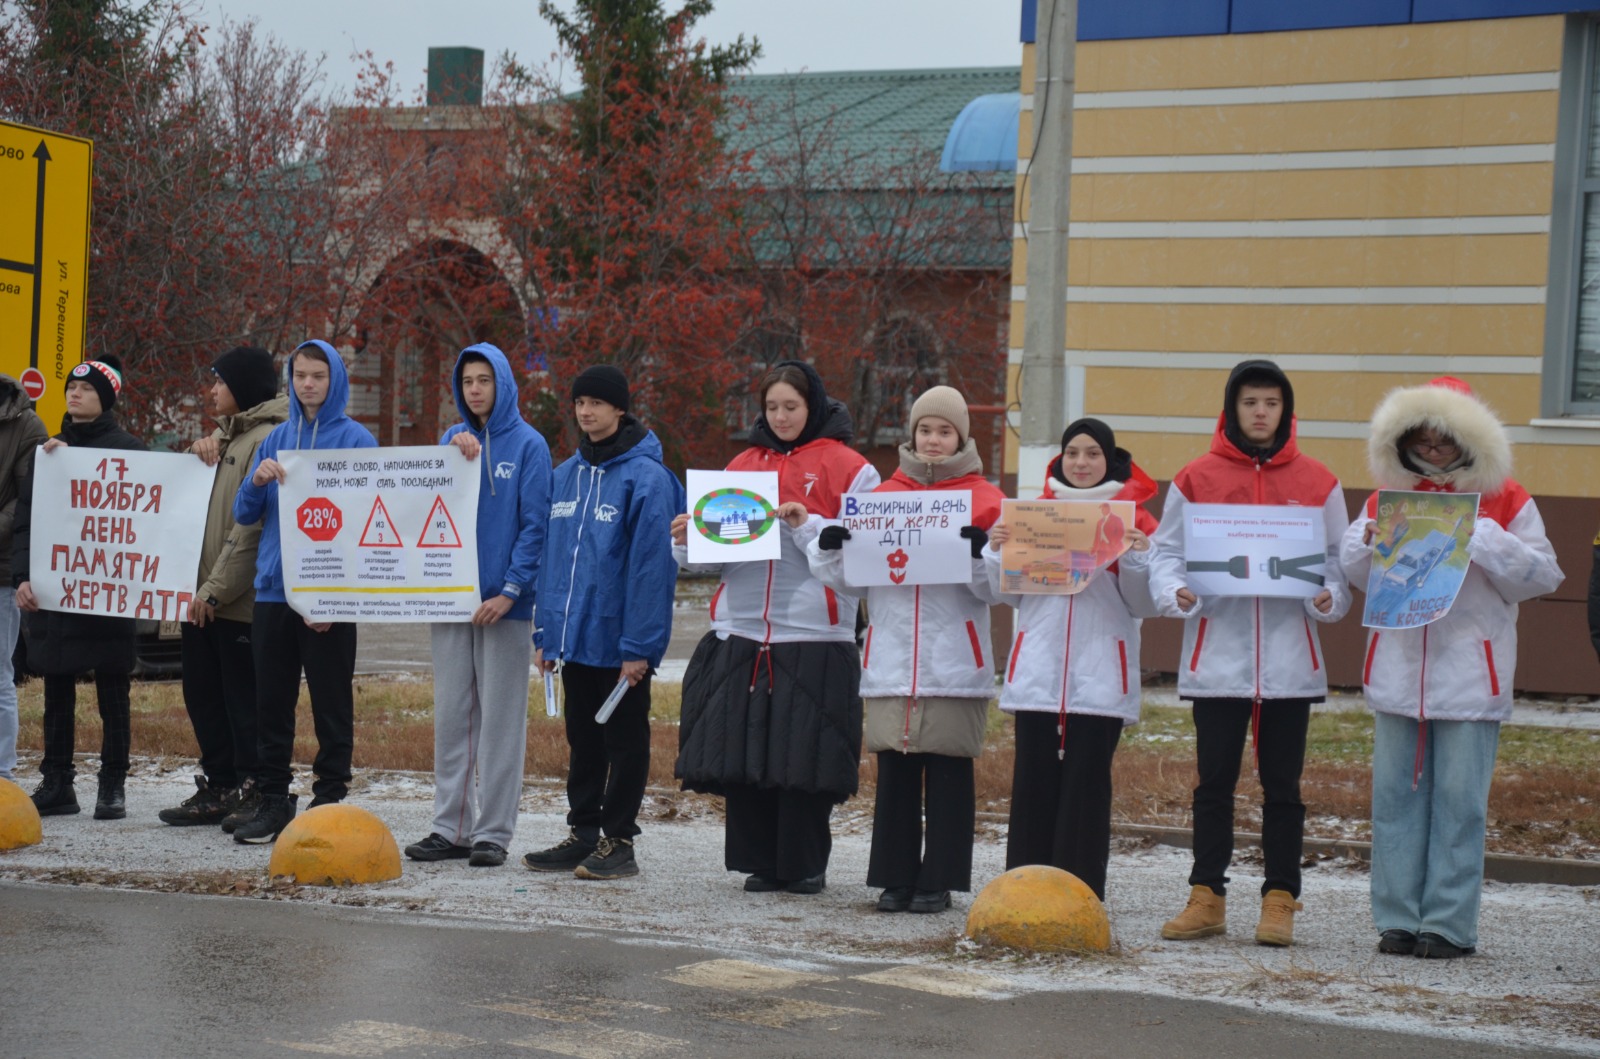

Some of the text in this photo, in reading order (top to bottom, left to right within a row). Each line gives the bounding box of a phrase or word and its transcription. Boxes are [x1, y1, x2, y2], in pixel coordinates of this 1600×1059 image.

[55, 260, 69, 380] ул. Терешковой
[96, 458, 129, 480] 17
[317, 459, 445, 474] КАЖДОЕ СЛОВО, НАПИСАННОЕ ЗА
[316, 477, 453, 490] РУЛЕМ, МОЖЕТ СТАТЬ ПОСЛЕДНИМ!
[70, 479, 162, 513] НОЯБРЯ
[377, 505, 382, 515] 1
[437, 505, 443, 515] 1
[845, 496, 967, 516] Всемирный день
[302, 507, 338, 529] 28%
[842, 516, 894, 531] ПАМЯТИ
[1193, 517, 1232, 525] Пристегни
[1233, 518, 1259, 526] ремень
[81, 516, 136, 544] ДЕНЬ
[378, 532, 383, 543] 3
[878, 529, 922, 546] ДТП
[1227, 531, 1255, 539] выбери
[439, 533, 445, 543] 5
[51, 544, 160, 583] ПАМЯТИ
[60, 577, 192, 622] ЖЕРТВ ДТП
[1370, 611, 1388, 625] НЕ
